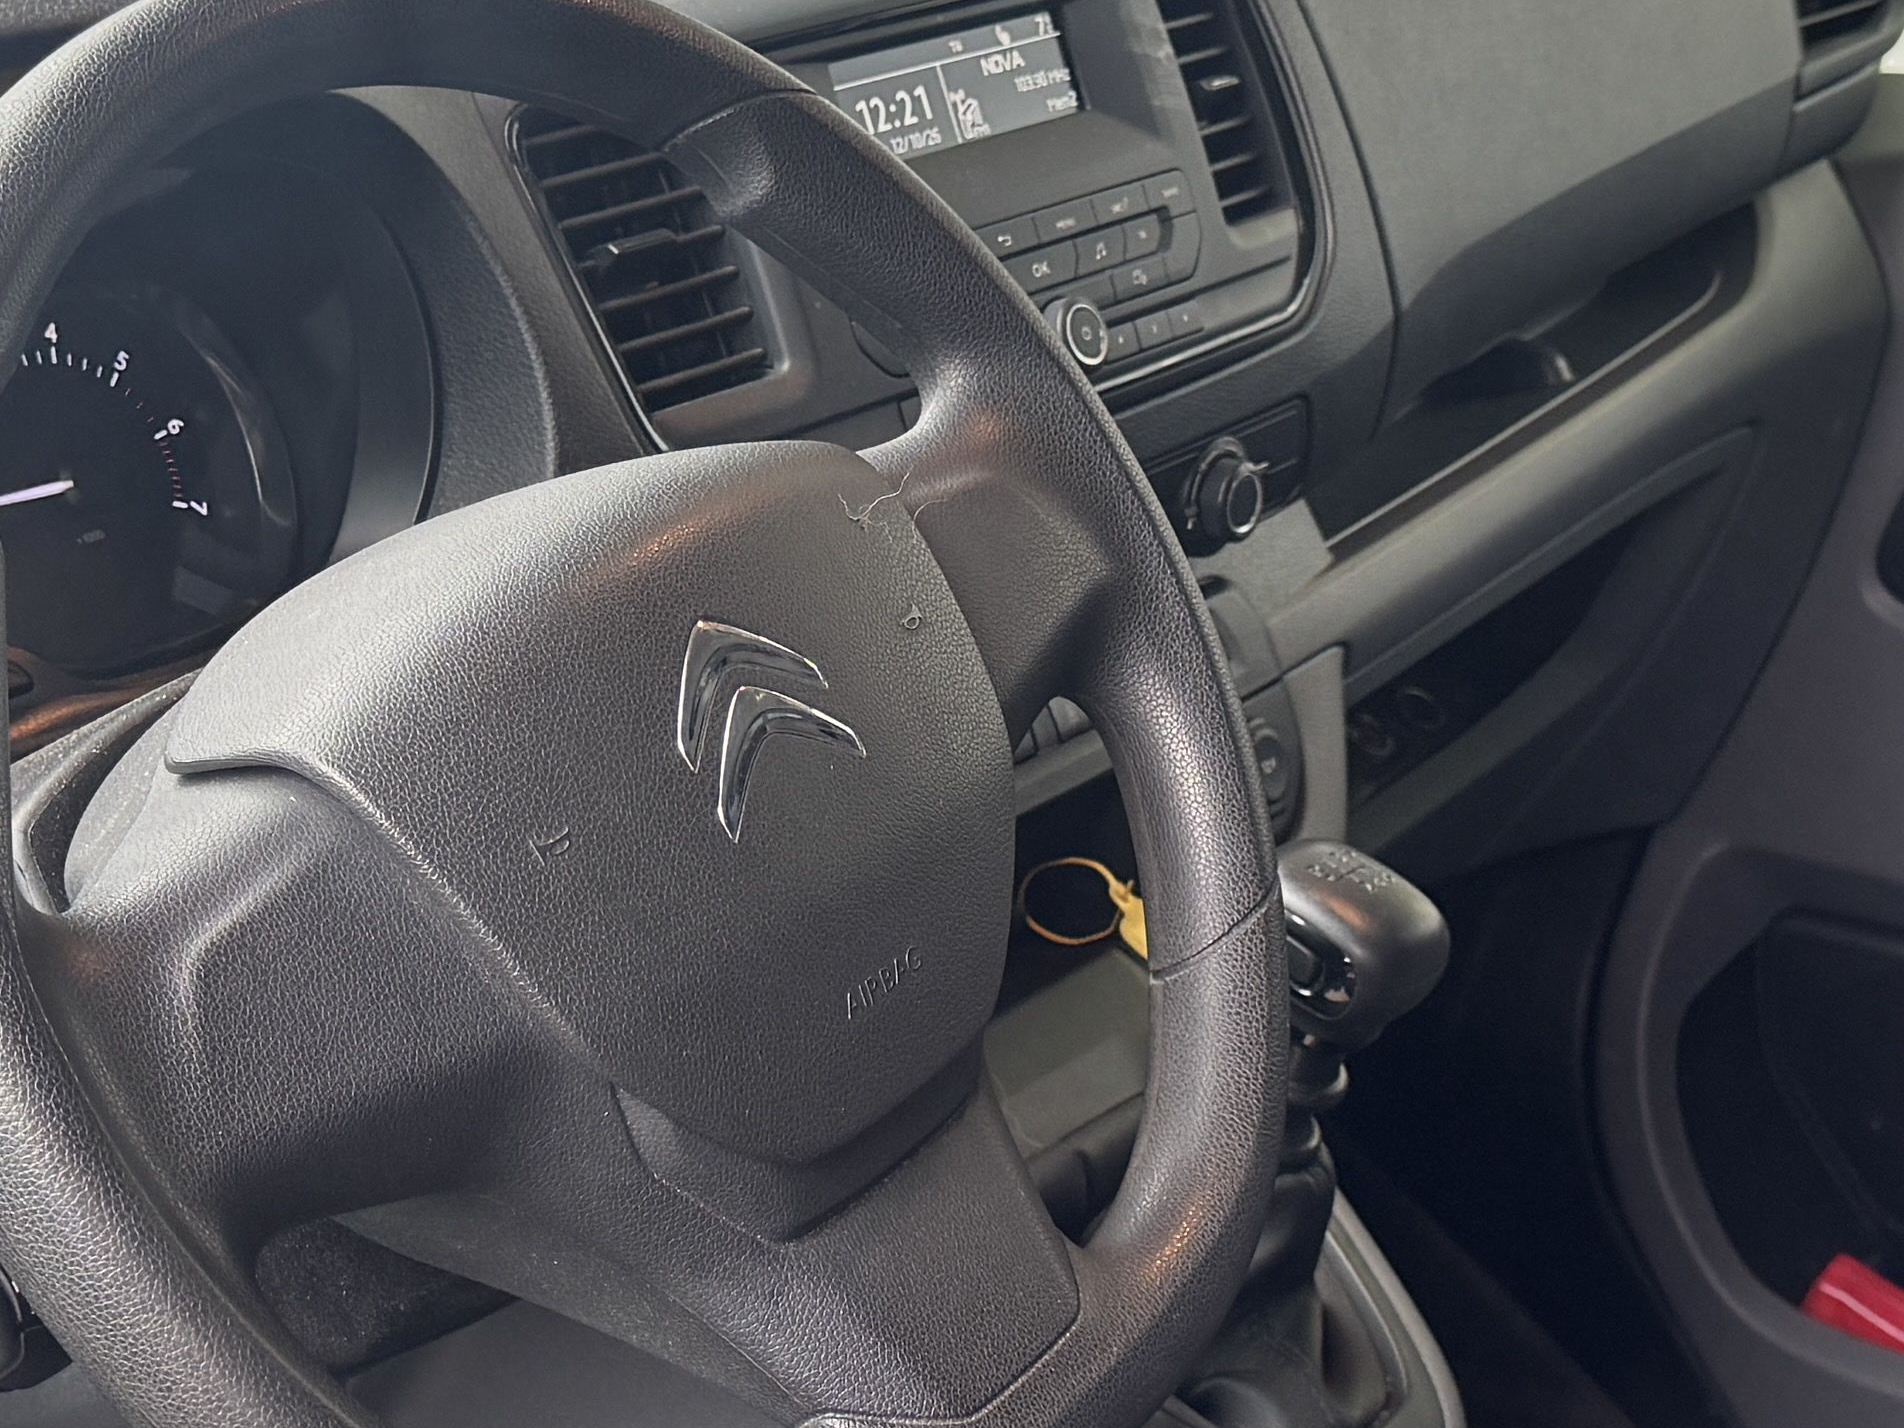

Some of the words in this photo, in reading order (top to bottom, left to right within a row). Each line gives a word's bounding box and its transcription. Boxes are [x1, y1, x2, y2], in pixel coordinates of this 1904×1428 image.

[981, 50, 1026, 76] NOVA
[855, 85, 934, 135] 12:21
[44, 322, 58, 343] 4
[113, 350, 130, 371] 5
[167, 419, 185, 435] 6
[189, 500, 208, 516] 7
[847, 946, 922, 1020] AIRBAG
